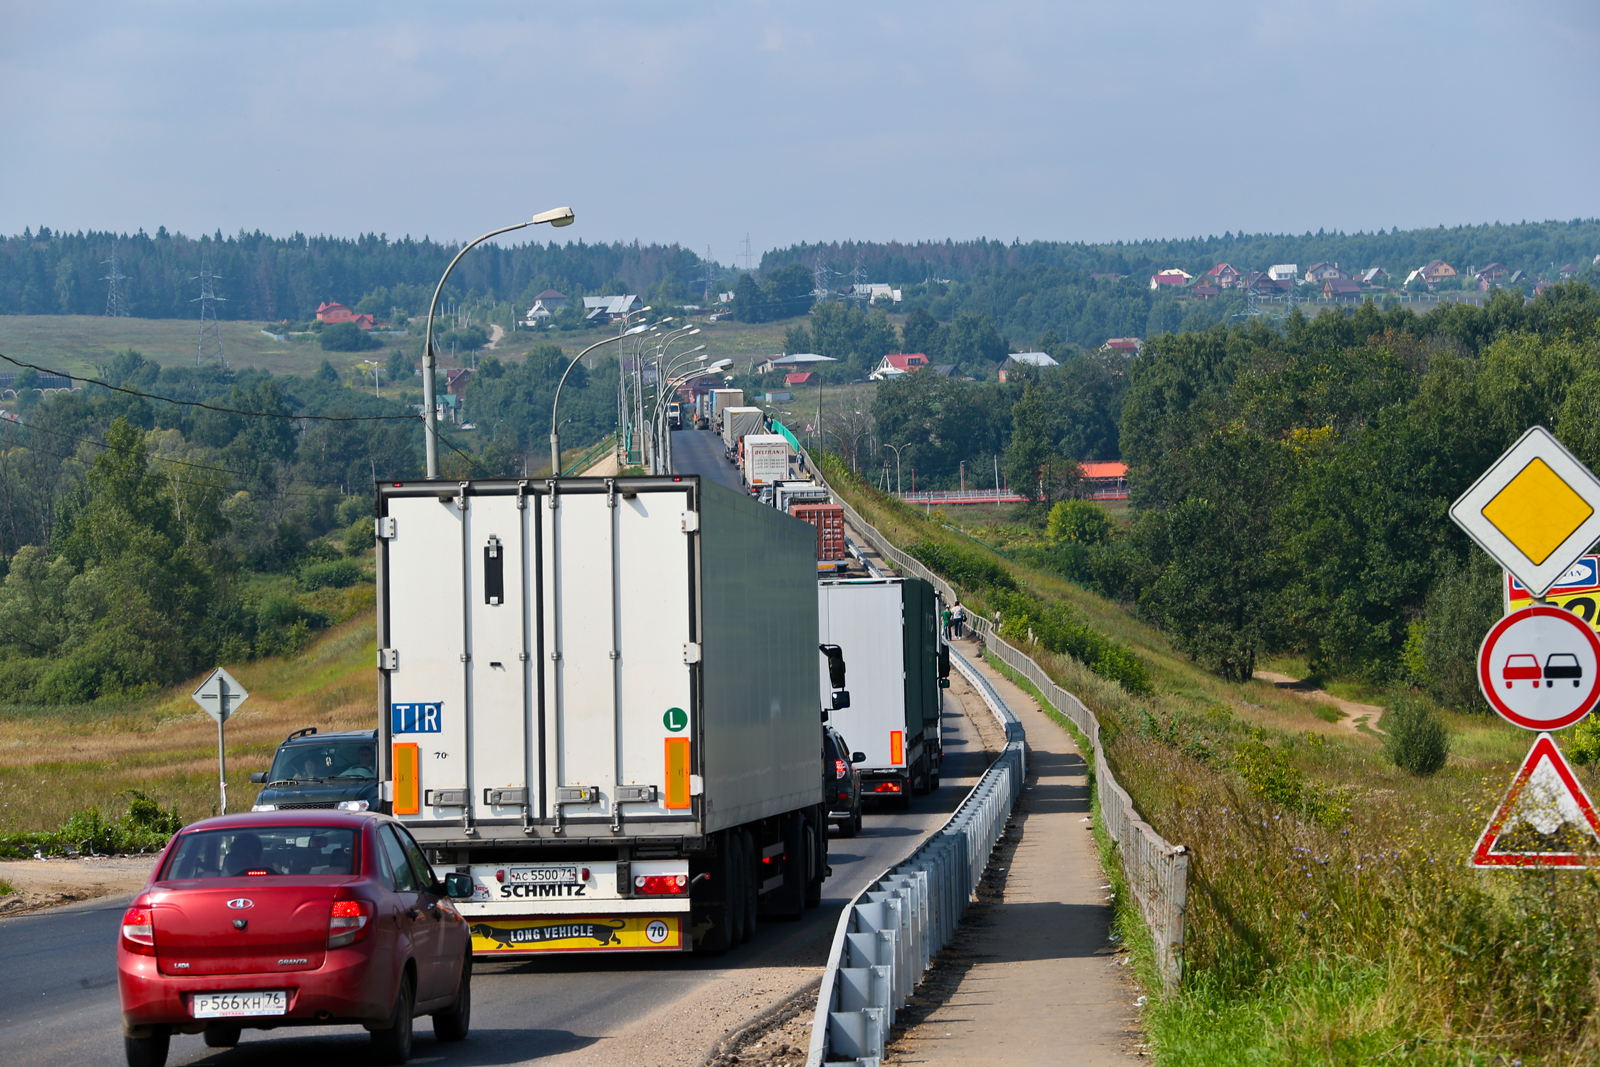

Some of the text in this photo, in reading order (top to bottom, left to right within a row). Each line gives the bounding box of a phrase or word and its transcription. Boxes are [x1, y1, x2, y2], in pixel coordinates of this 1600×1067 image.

[396, 705, 438, 731] TIR
[669, 711, 681, 728] L
[435, 751, 448, 759] 70
[500, 884, 586, 898] SCHMITZ
[510, 925, 593, 942] LONG VEHICLE
[650, 926, 664, 938] 70
